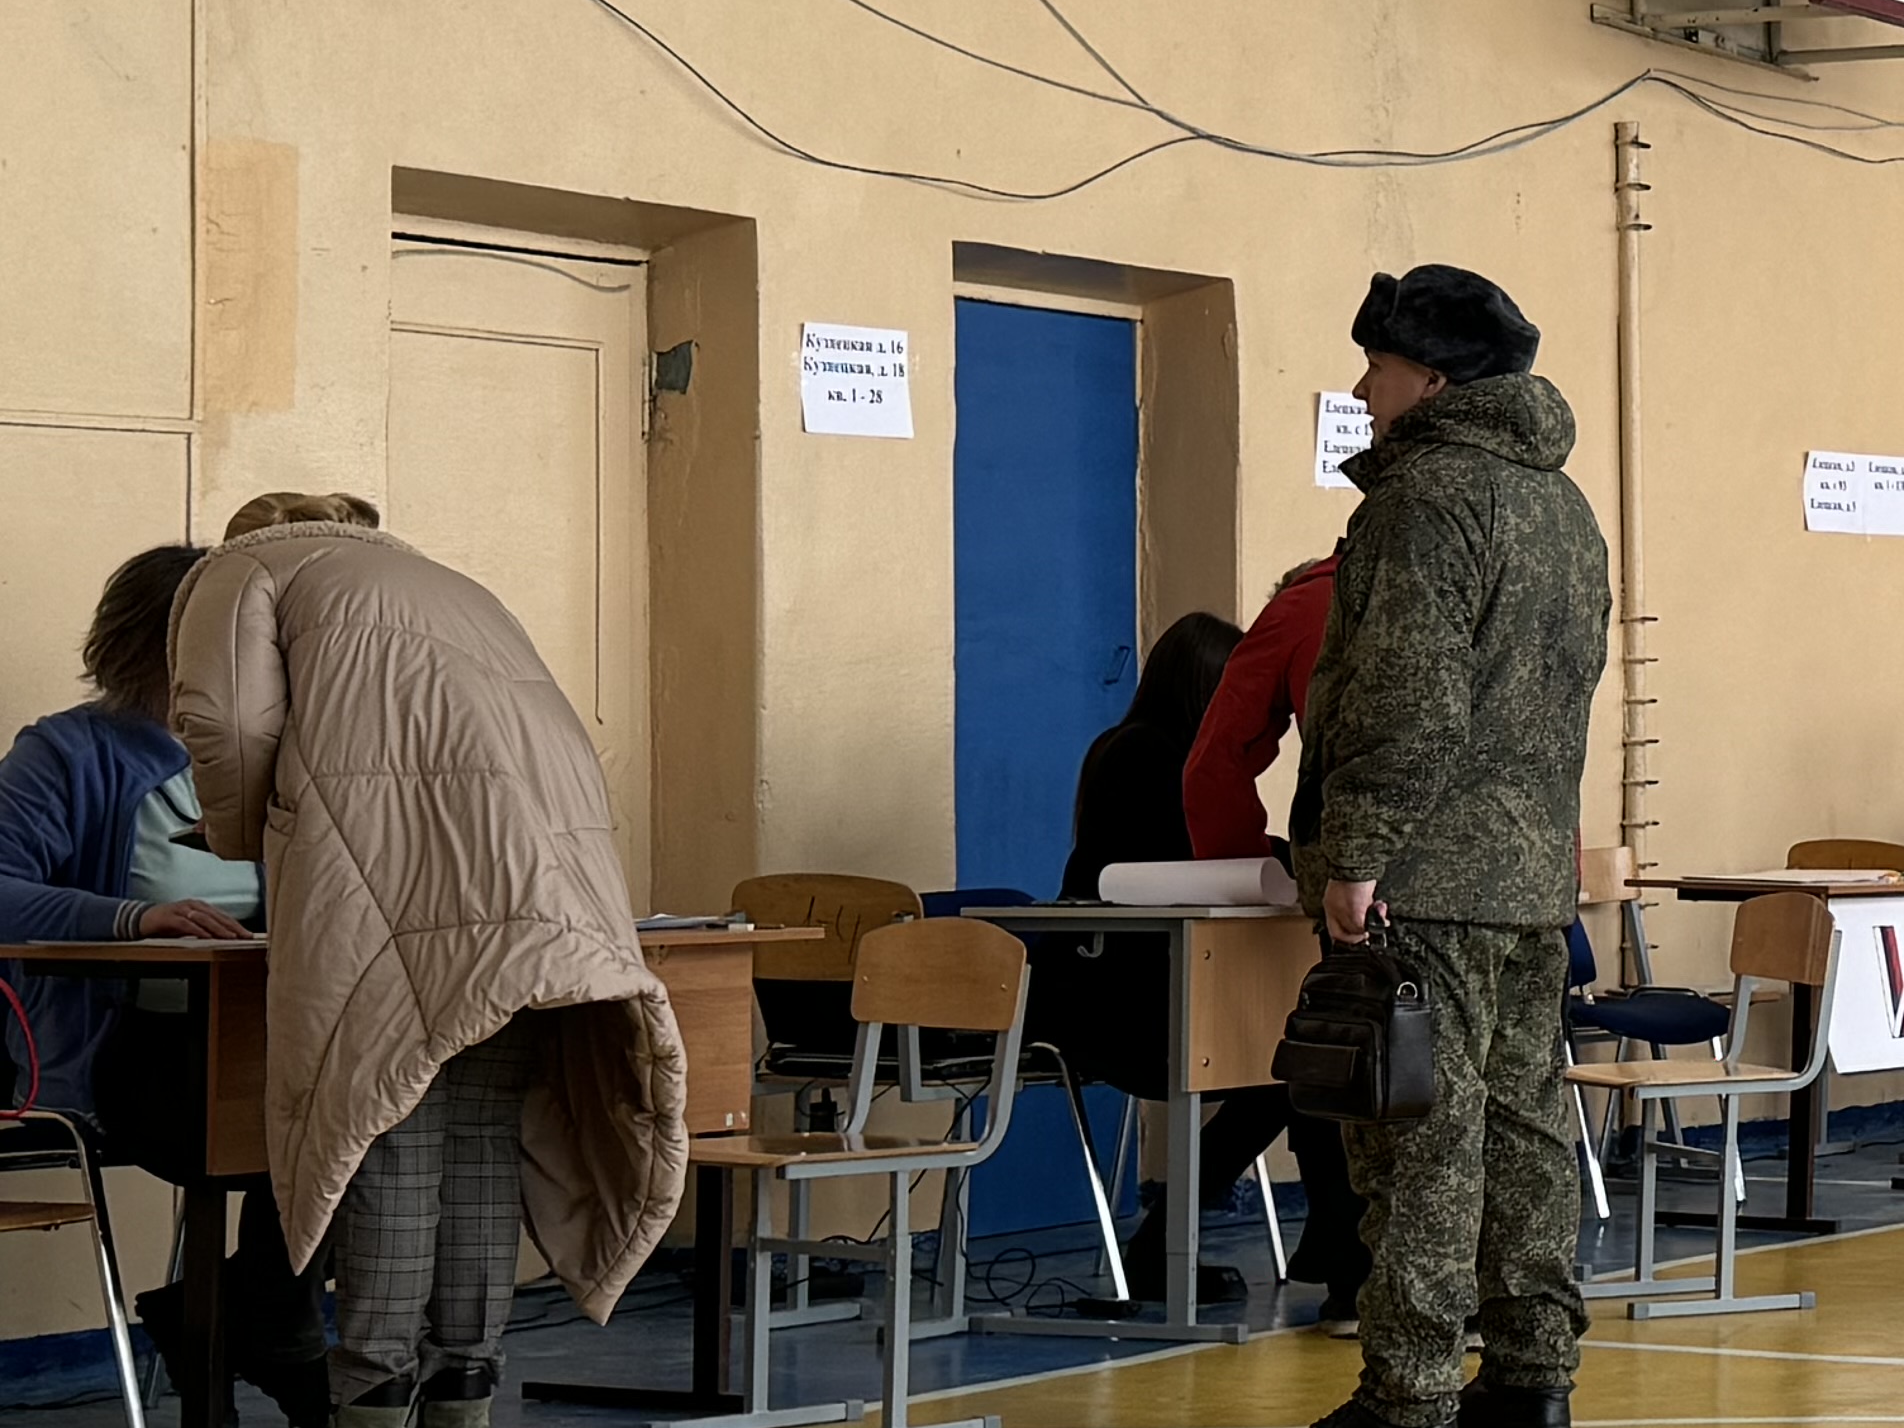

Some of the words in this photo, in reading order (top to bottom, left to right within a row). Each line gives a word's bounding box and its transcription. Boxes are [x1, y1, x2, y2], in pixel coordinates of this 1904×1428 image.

[891, 340, 904, 354] 16
[893, 363, 905, 377] 18
[869, 388, 883, 404] 28
